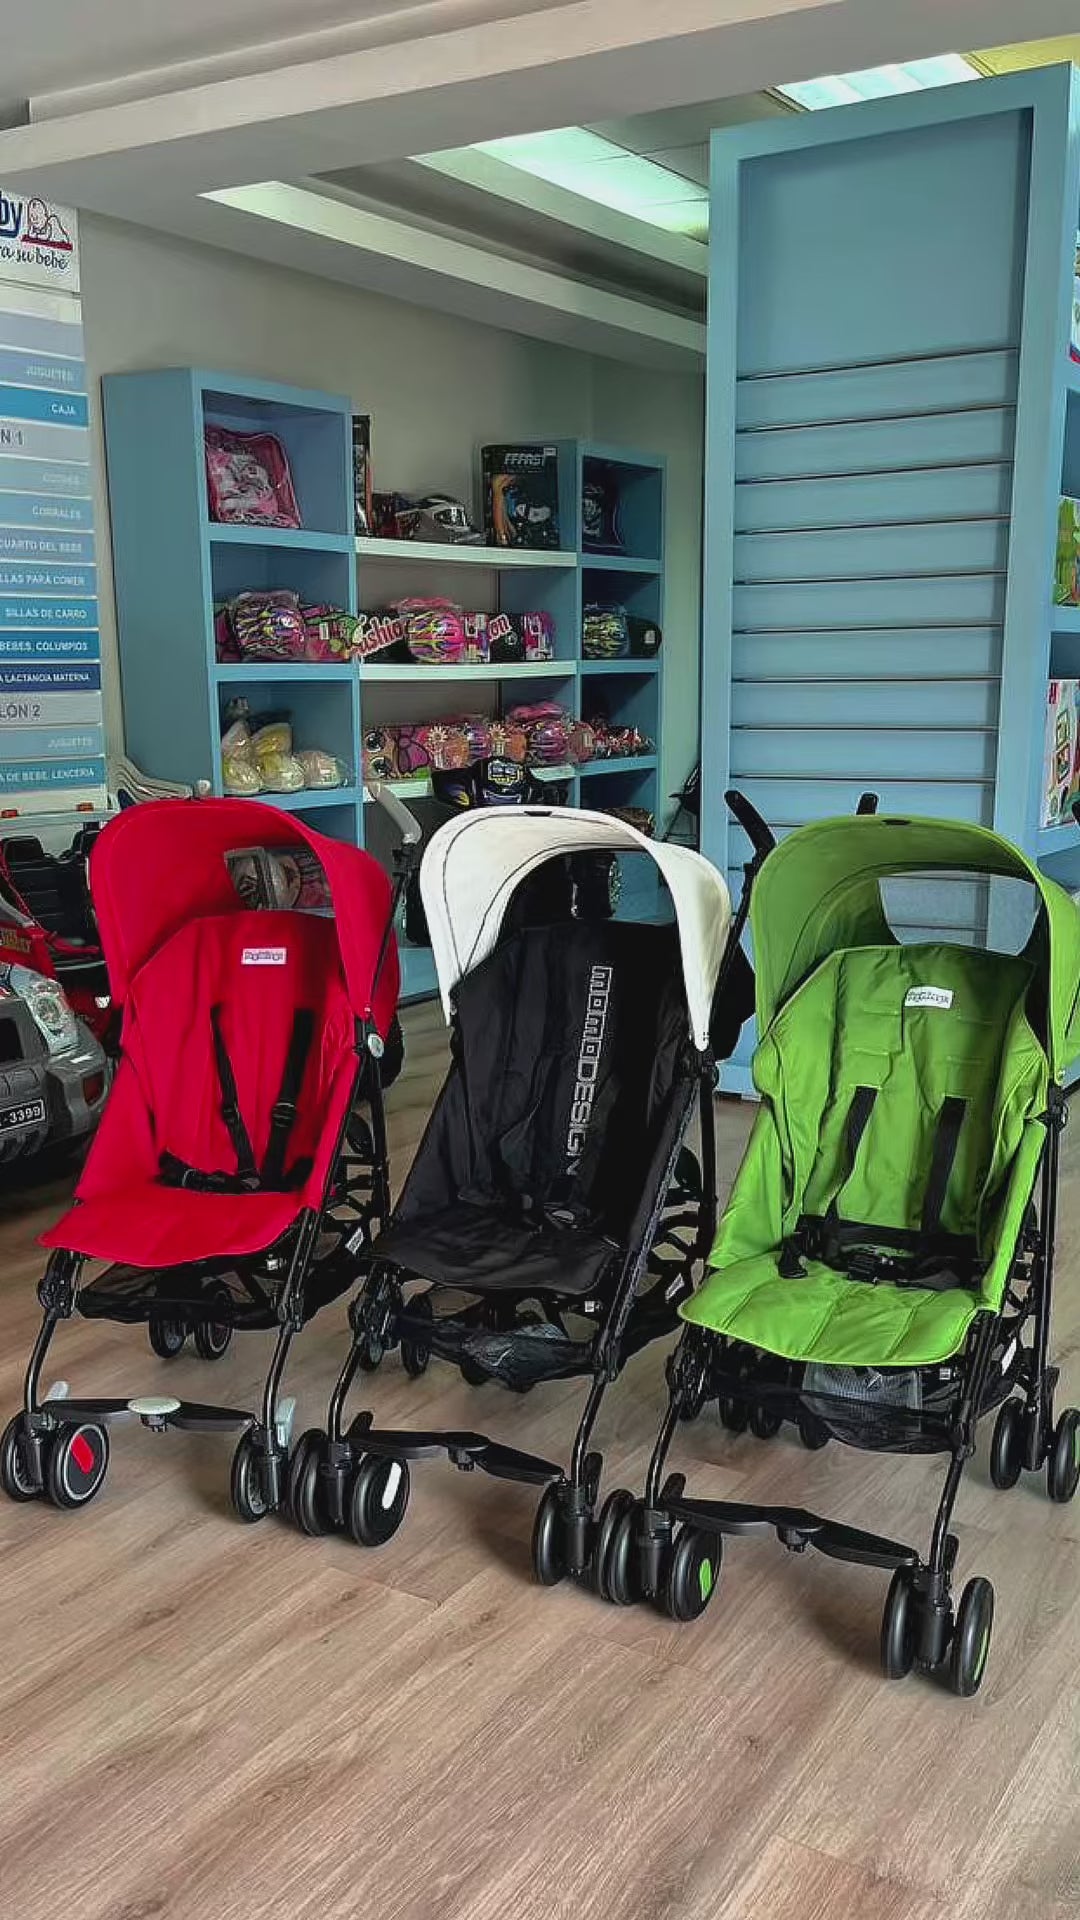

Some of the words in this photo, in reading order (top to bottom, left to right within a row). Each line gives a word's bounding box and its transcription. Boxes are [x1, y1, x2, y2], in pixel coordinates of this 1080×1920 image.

[51, 403, 76, 416] CAJA
[40, 540, 57, 552] DEL
[25, 573, 52, 586] PARA
[5, 607, 39, 618] SILLAS
[41, 608, 53, 619] DE
[55, 609, 88, 620] CARRO
[36, 641, 88, 651] COLUMPIOS
[53, 672, 90, 682] MATERNA
[32, 704, 41, 718] 2
